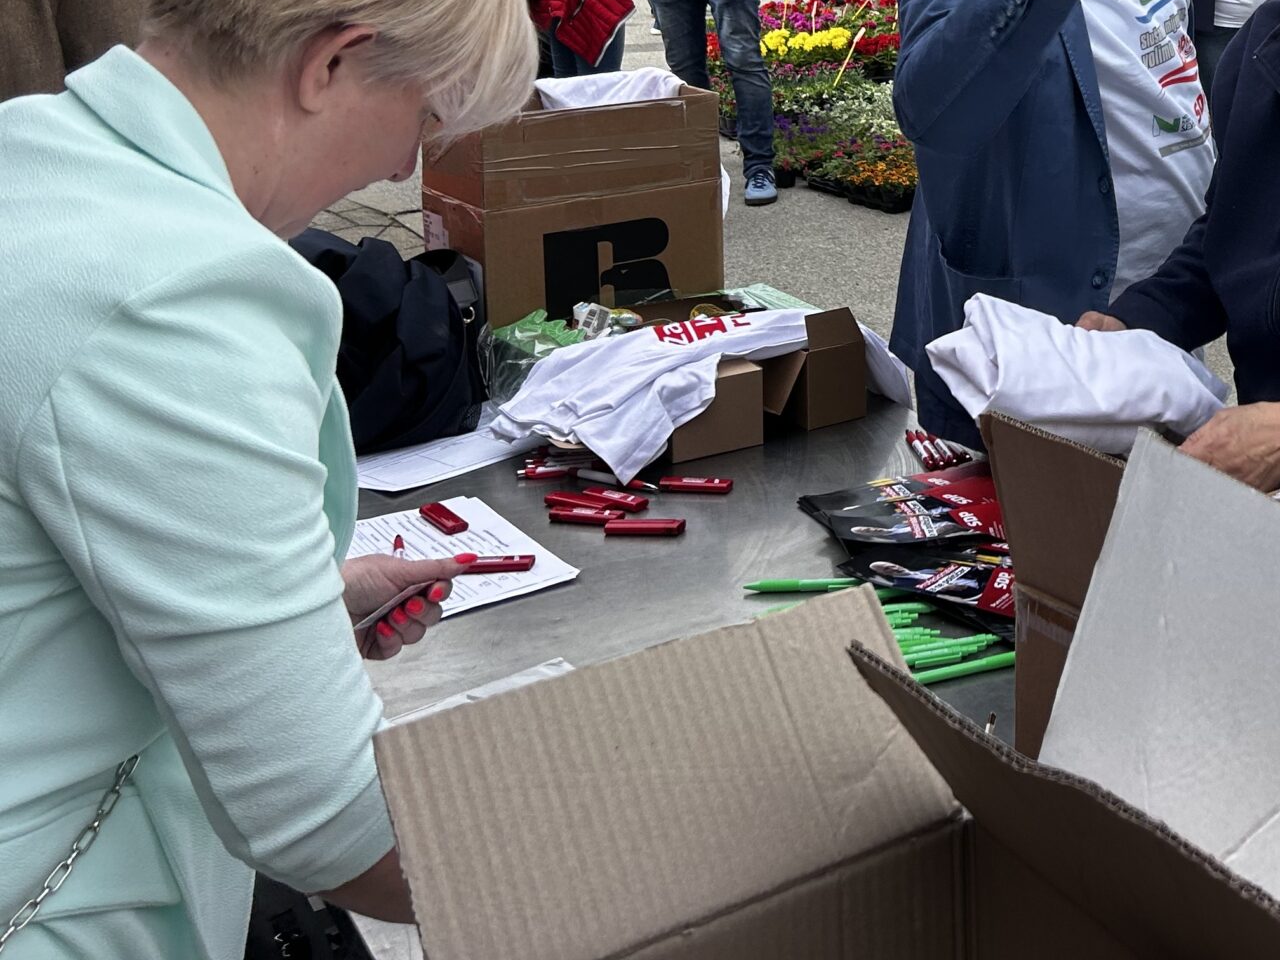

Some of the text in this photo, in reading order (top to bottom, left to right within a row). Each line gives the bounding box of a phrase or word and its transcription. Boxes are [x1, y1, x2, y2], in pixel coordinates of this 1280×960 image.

[942, 494, 973, 505] SDP
[958, 511, 982, 527] SDP
[994, 572, 1012, 590] SDP
